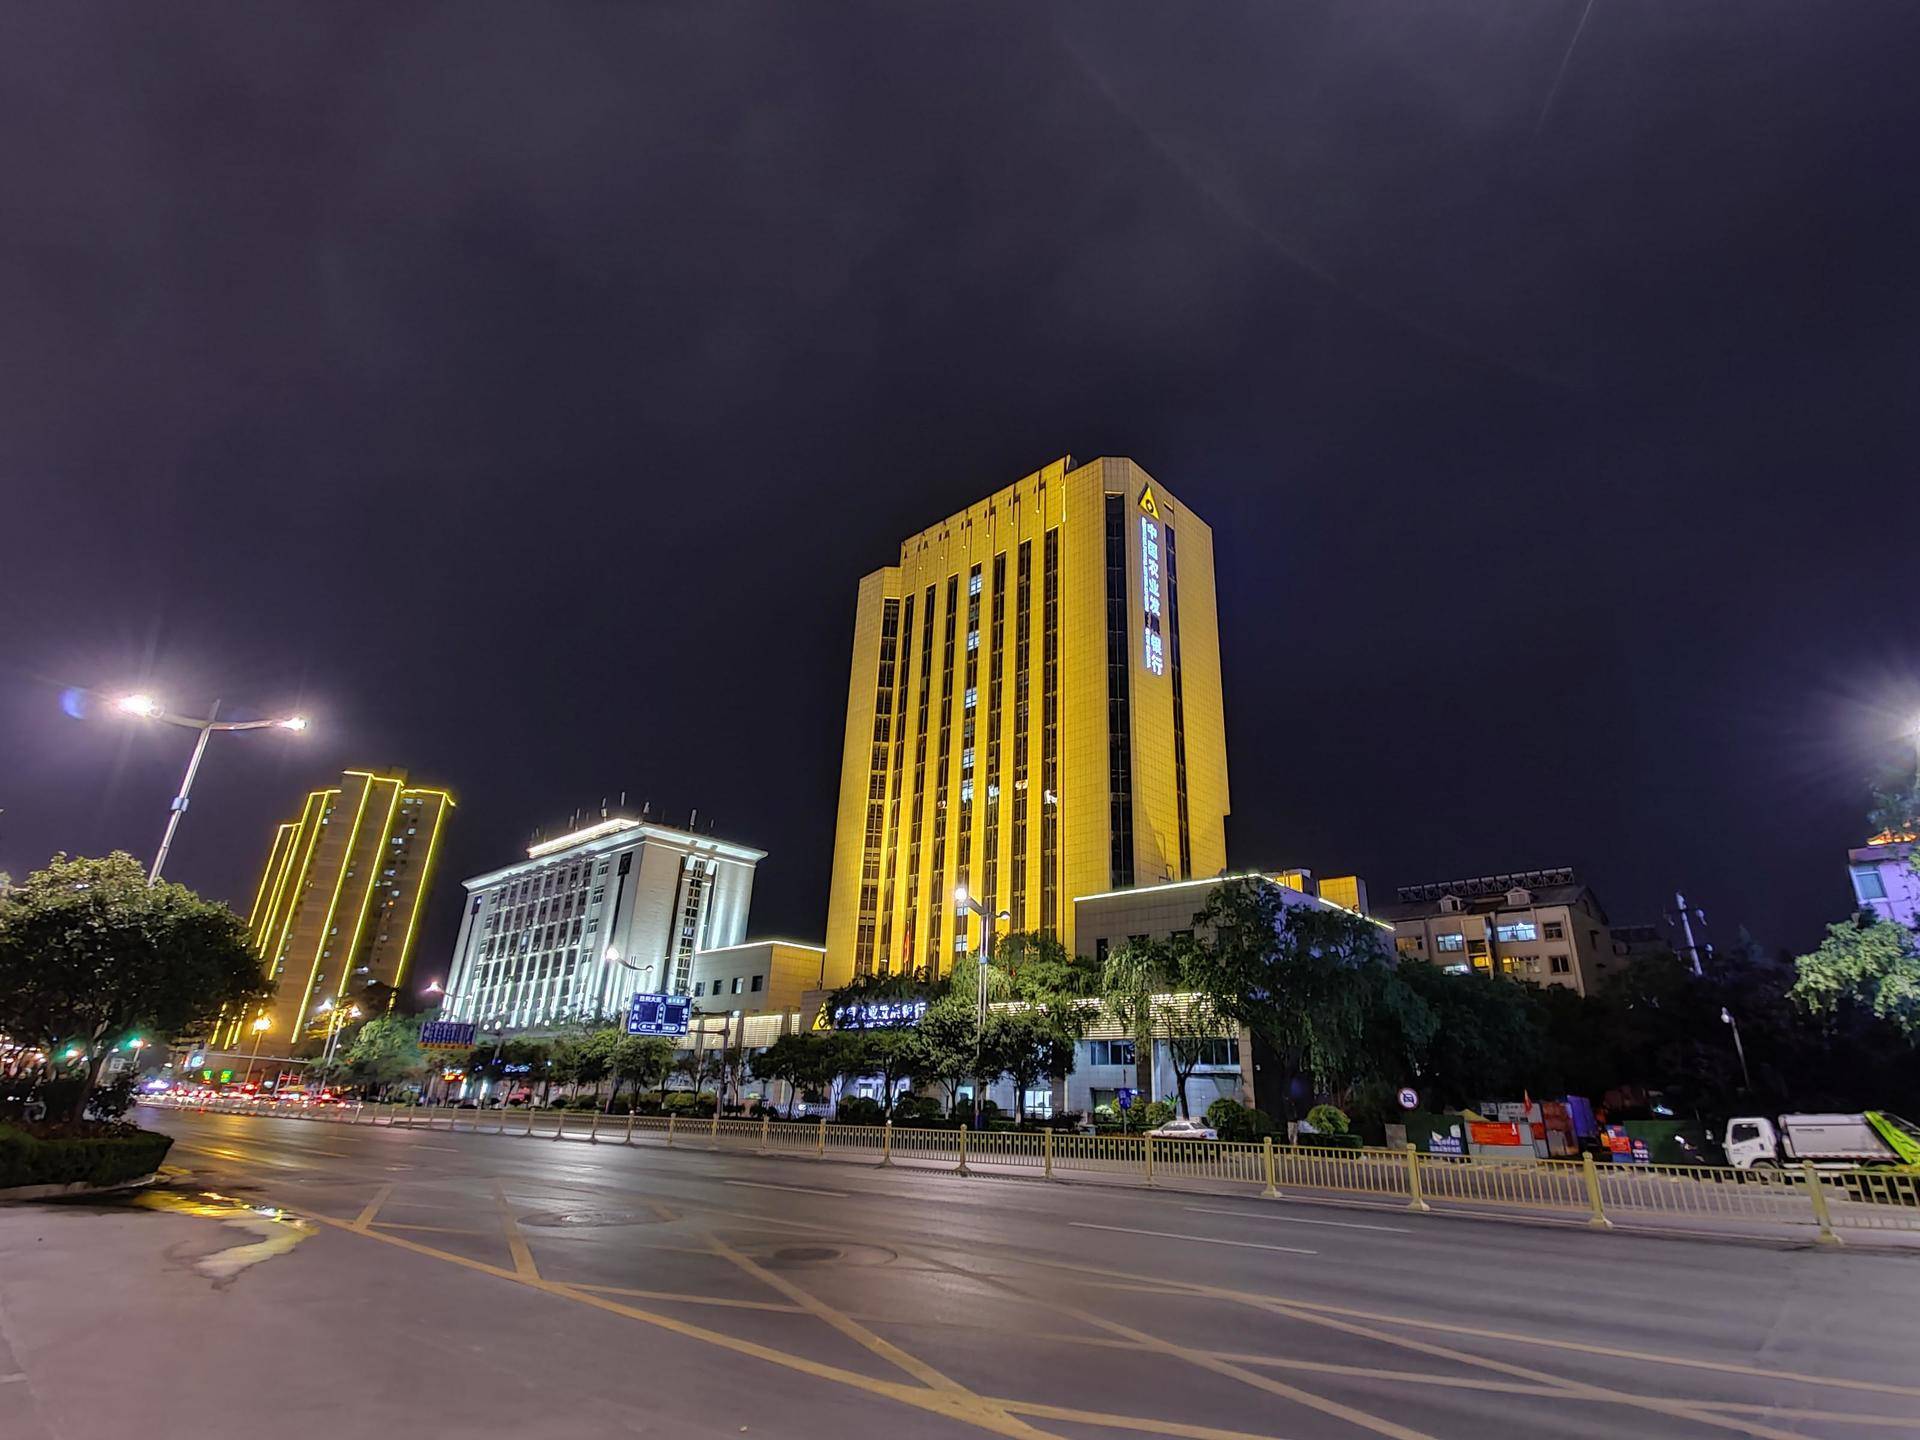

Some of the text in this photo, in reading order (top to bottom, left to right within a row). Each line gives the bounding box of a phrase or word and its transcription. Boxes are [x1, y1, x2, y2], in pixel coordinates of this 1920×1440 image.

[1146, 523, 1163, 676] 中国农业发银行
